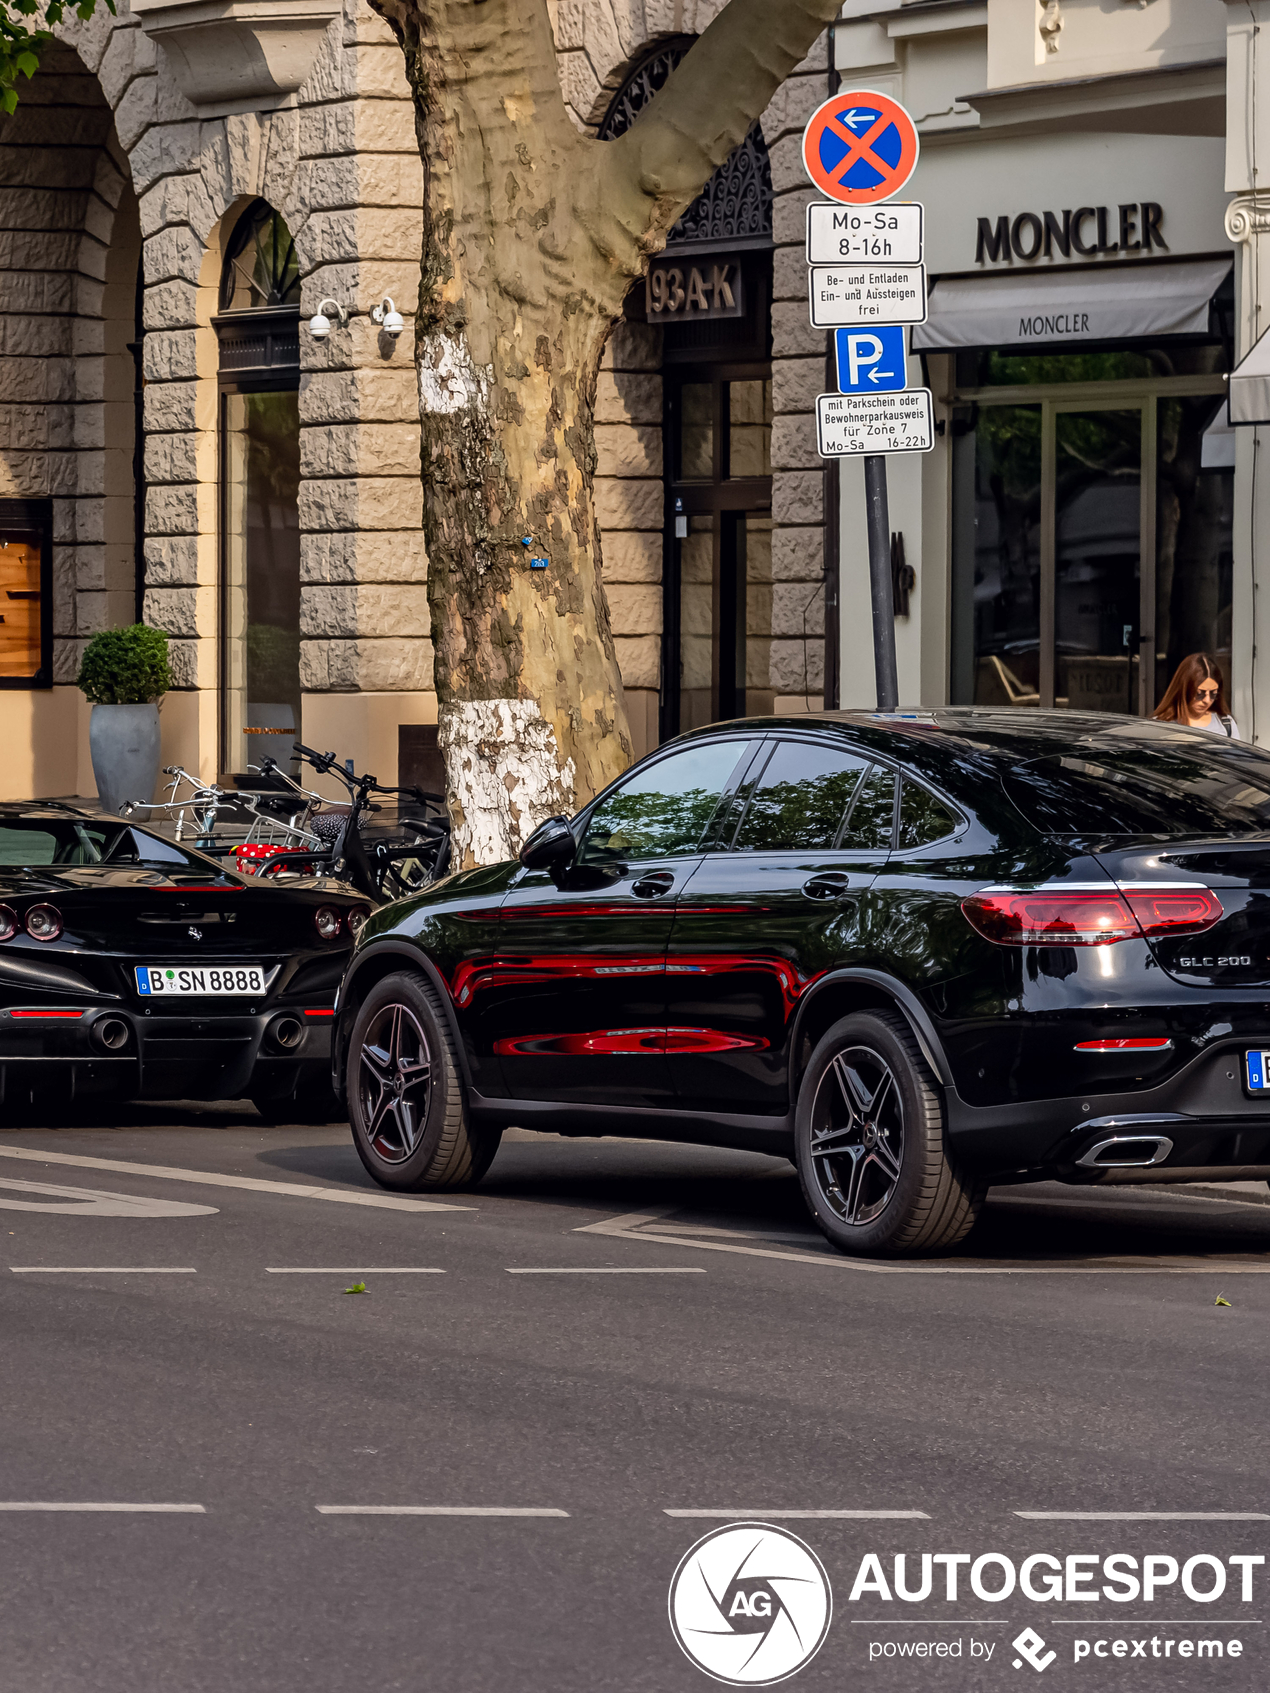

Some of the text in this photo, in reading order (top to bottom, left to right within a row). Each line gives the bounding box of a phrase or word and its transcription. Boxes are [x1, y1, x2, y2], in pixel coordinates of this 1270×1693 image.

[833, 212, 898, 229] Mo-Sa
[974, 202, 1169, 263] MONCLER
[839, 238, 892, 255] 8-16h
[827, 272, 909, 286] Be- und Entladen
[821, 288, 916, 302] Ein- und Aussteigen
[859, 304, 880, 315] frei
[1019, 313, 1090, 336] MONCLER
[847, 333, 884, 385] P
[828, 395, 920, 411] mit Parkschein oder
[825, 408, 924, 424] Bewohnerparkausweis
[843, 423, 908, 437] für Zone 7
[826, 436, 926, 452] Mo-Sa 16-22h
[1180, 956, 1251, 967] GLC 200
[150, 971, 164, 991] B
[178, 970, 206, 991] SN
[210, 970, 261, 991] 8888
[1252, 1073, 1259, 1083] D
